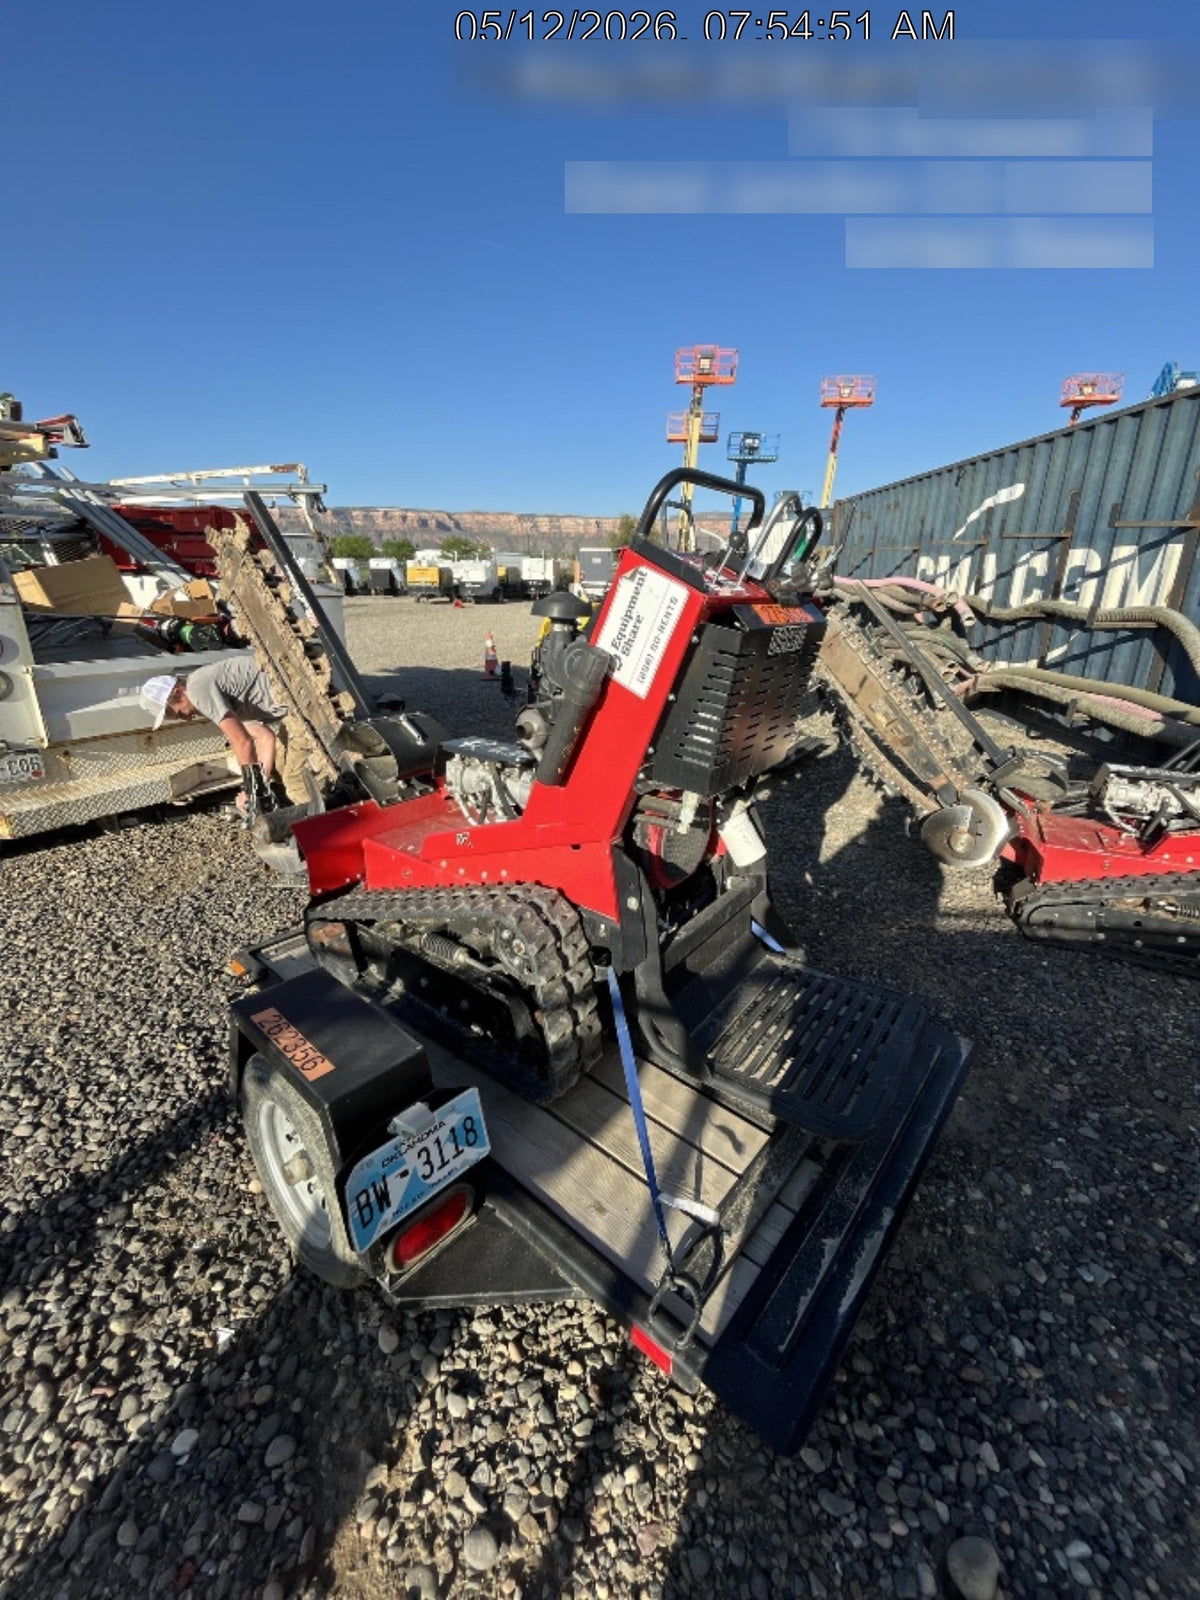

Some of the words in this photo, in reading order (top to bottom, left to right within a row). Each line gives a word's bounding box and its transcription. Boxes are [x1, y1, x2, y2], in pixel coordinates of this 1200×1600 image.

[1009, 543, 1185, 609] CGM
[611, 569, 648, 651] Equipment
[621, 614, 644, 657] Share
[257, 1014, 326, 1071] 262356
